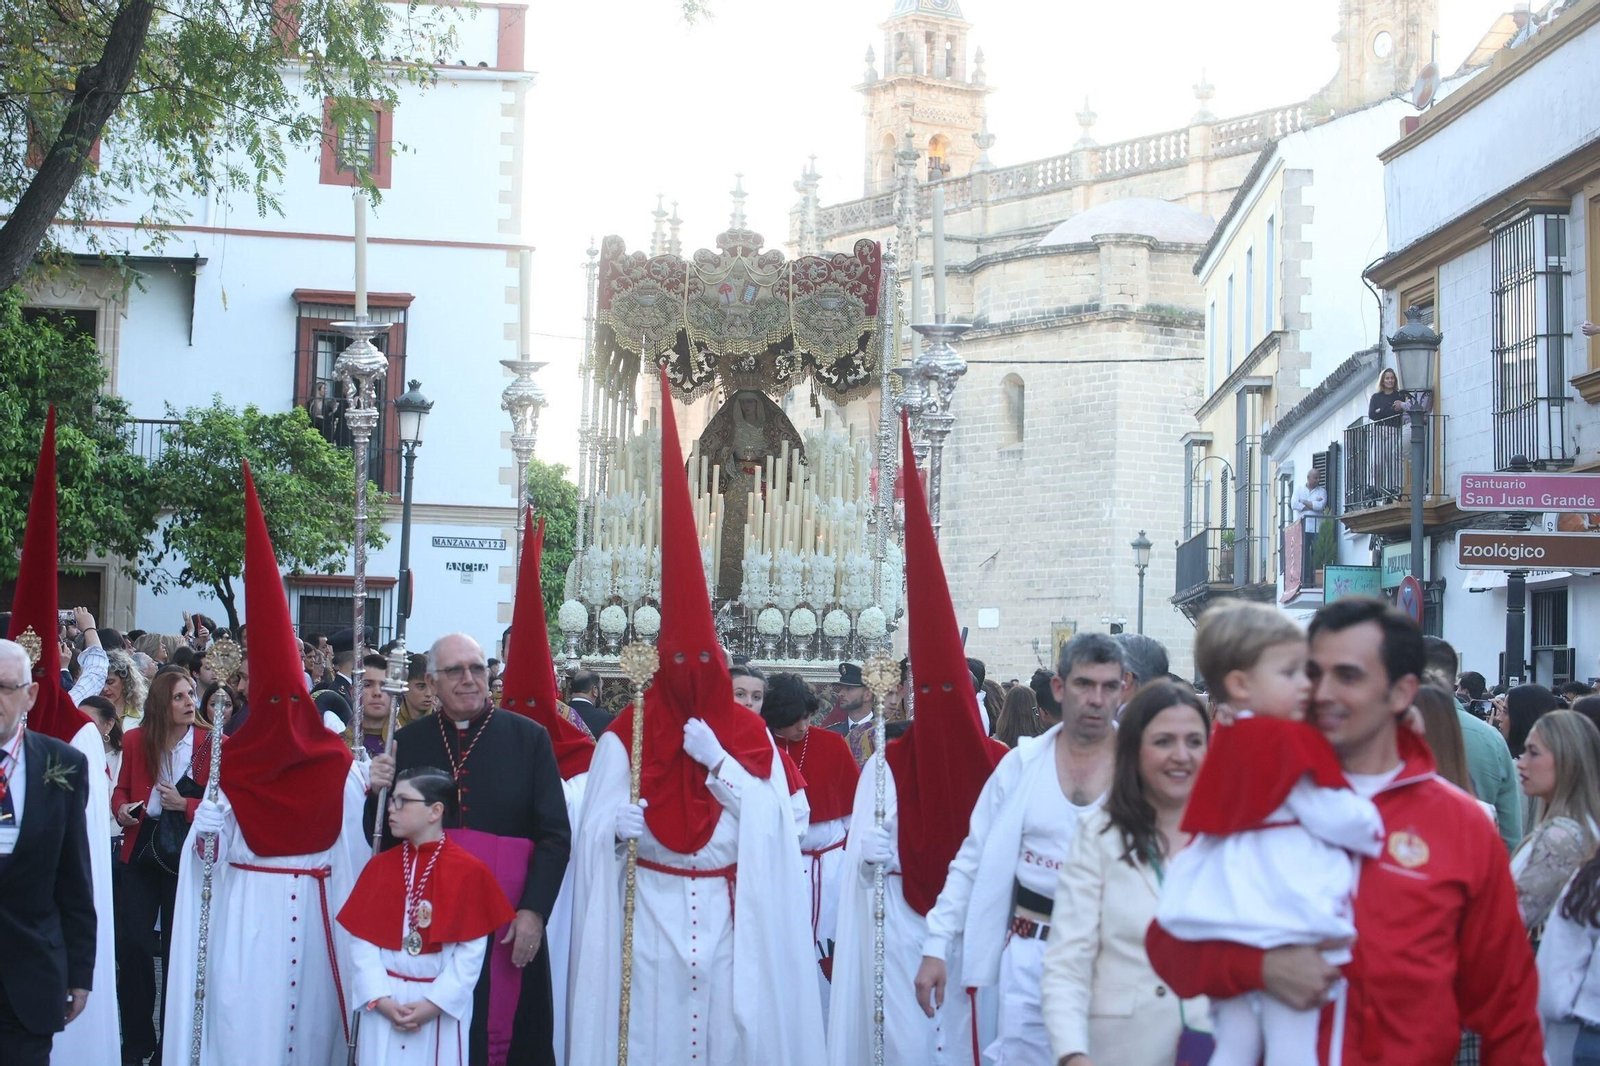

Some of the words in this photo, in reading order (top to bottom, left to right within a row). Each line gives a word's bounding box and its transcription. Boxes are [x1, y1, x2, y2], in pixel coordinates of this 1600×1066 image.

[1465, 478, 1526, 489] Santuario
[1465, 492, 1493, 505] San
[1499, 493, 1534, 505] Juan
[1541, 493, 1596, 506] Grande
[434, 538, 476, 547] MANZANA
[1463, 543, 1545, 560] zoológico
[446, 562, 488, 571] ANCHA
